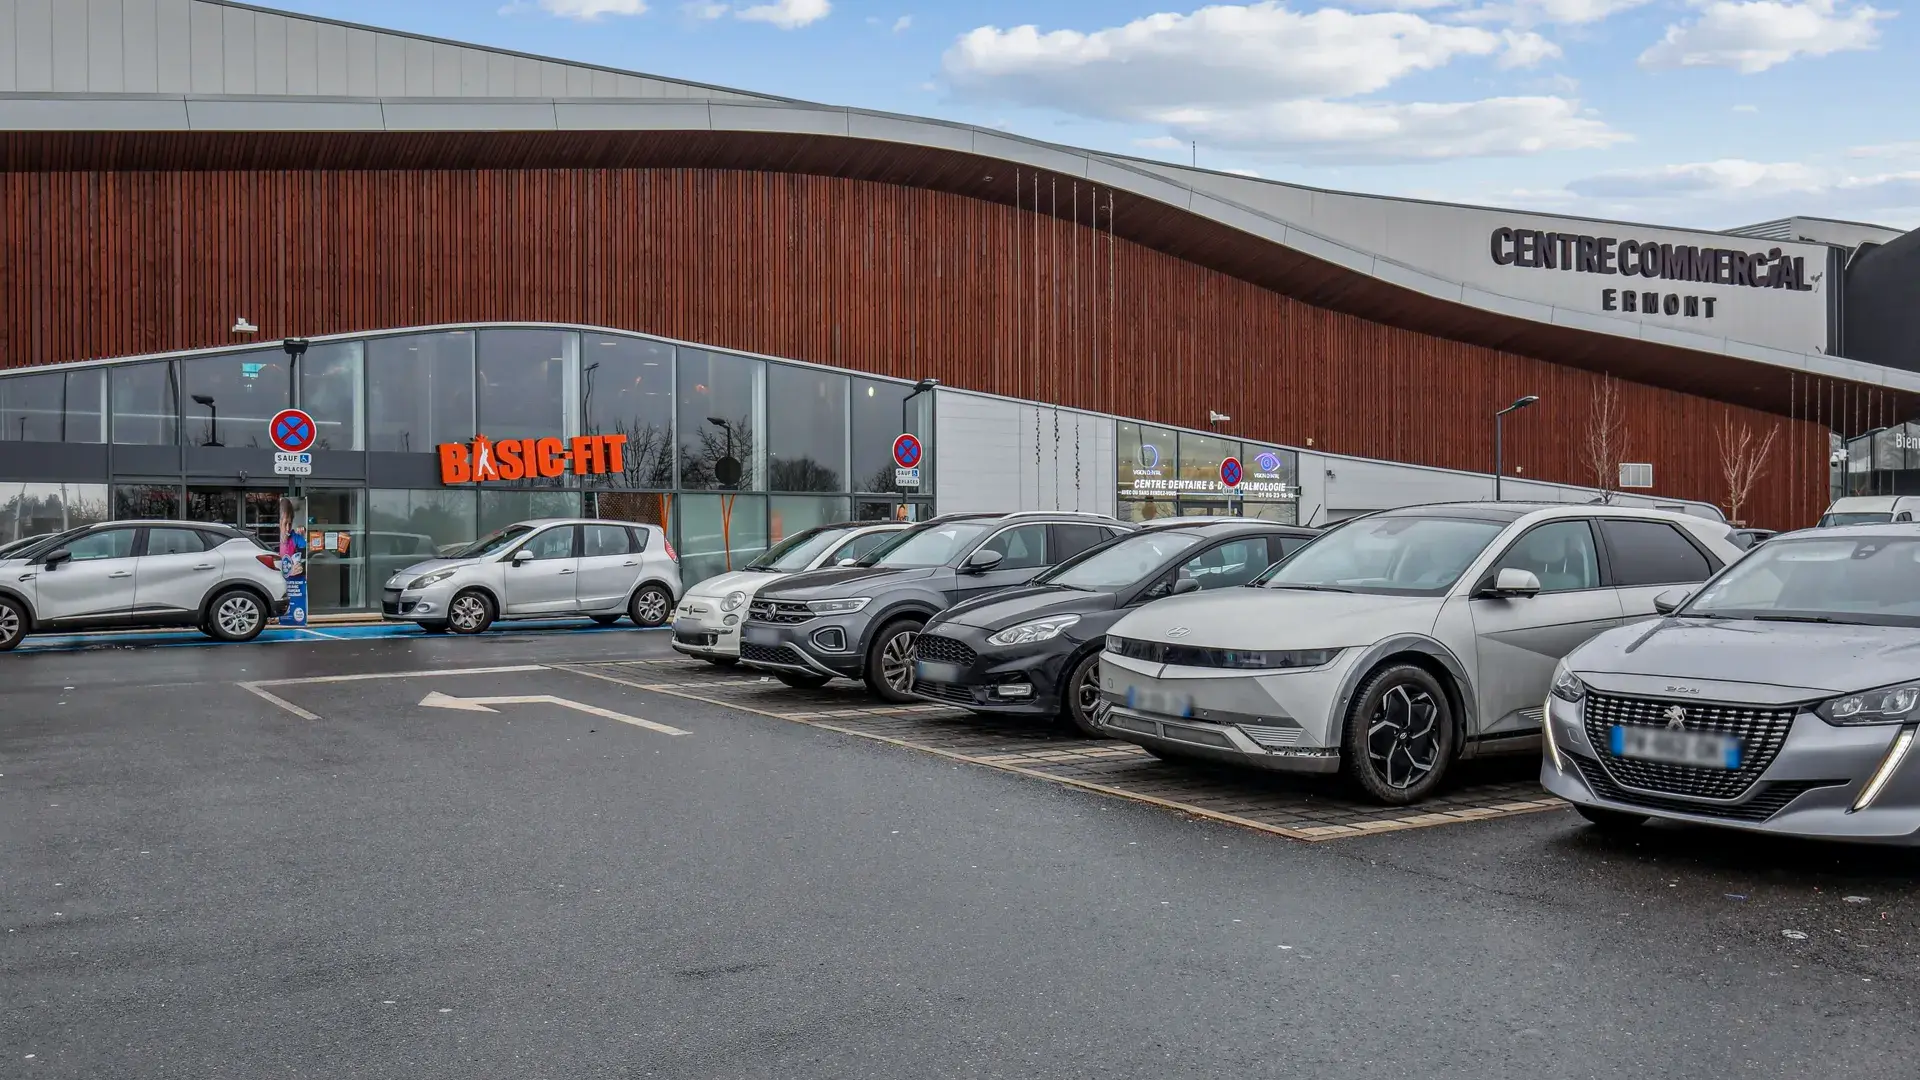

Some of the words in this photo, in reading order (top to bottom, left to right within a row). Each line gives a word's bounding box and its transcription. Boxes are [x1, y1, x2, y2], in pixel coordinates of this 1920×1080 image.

[1602, 288, 1717, 318] ERMONT
[1896, 432, 1920, 449] Bien
[438, 433, 627, 484] BASIC-FIT
[1134, 479, 1167, 489] CENTRE
[1168, 480, 1207, 490] DENTAIRE
[1208, 480, 1214, 490] &
